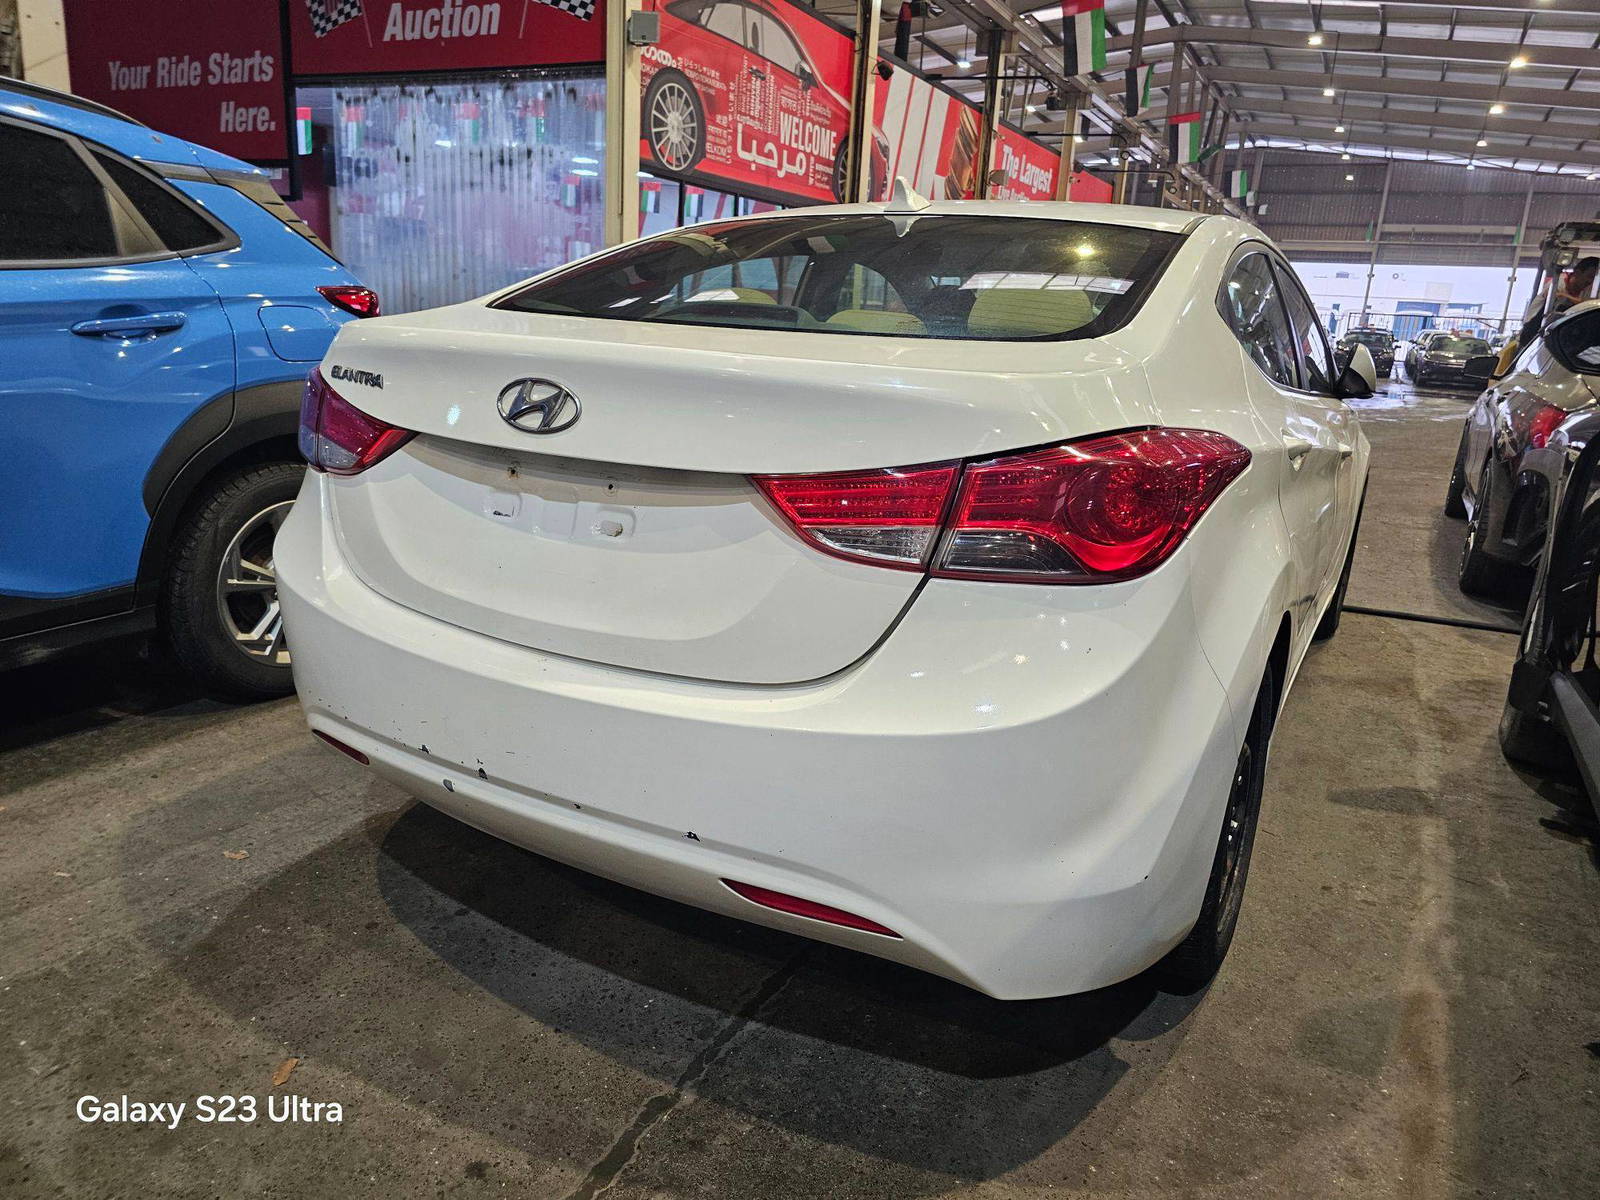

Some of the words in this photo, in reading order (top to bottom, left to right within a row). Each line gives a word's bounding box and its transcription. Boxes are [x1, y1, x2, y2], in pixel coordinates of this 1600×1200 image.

[383, 0, 501, 42] Auction
[108, 61, 151, 92] Your
[156, 55, 201, 88] Ride
[208, 51, 274, 85] Starts
[219, 101, 277, 133] Here.
[780, 112, 837, 160] WELCOME
[737, 123, 806, 177] مرحبا
[1001, 145, 1019, 179] The
[1019, 155, 1053, 193] Largest
[331, 365, 384, 390] ELANTRA
